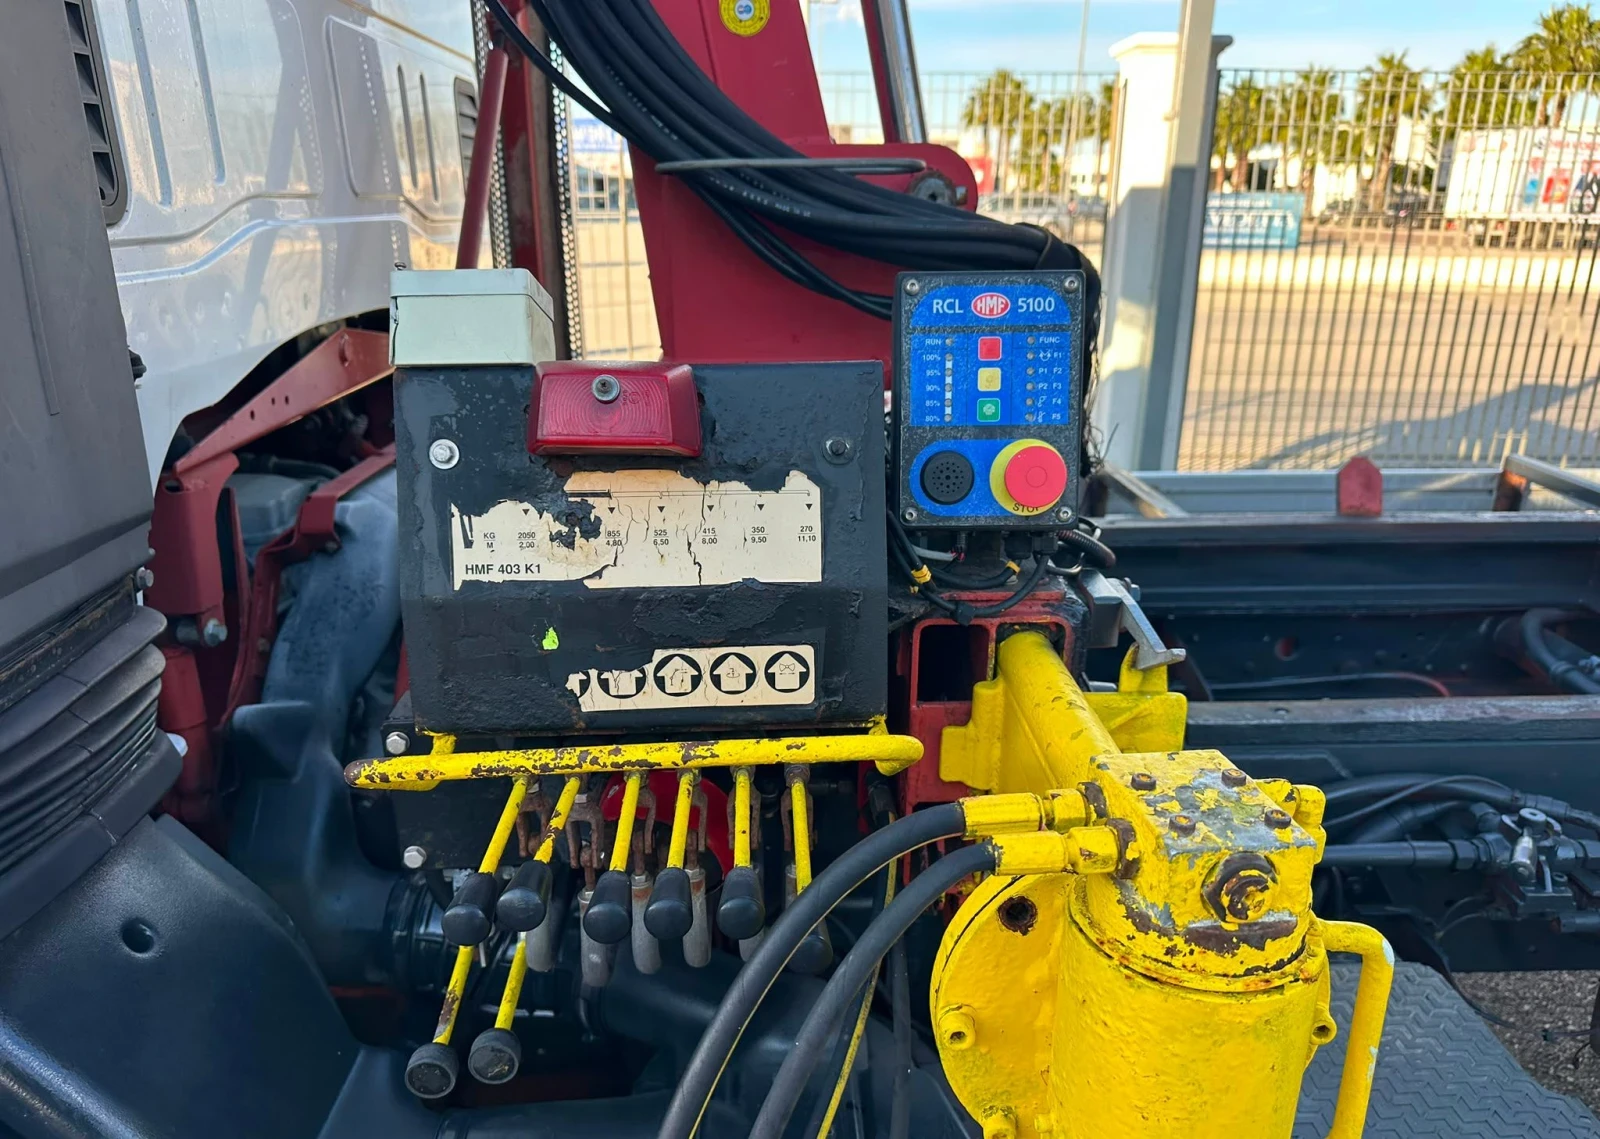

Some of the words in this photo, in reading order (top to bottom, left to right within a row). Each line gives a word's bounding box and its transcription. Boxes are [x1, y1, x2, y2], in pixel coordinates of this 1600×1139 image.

[933, 299, 963, 314] RCL
[976, 295, 1006, 315] HMF
[1018, 297, 1055, 312] 5100
[751, 526, 765, 534] 350
[800, 525, 813, 533] 270
[606, 539, 622, 547] 4,80
[653, 538, 669, 546] 6,50
[702, 537, 718, 545] 8,00
[751, 536, 767, 544] 9,50
[465, 564, 494, 575] HMF
[497, 564, 520, 575] 403
[525, 563, 541, 574] K1
